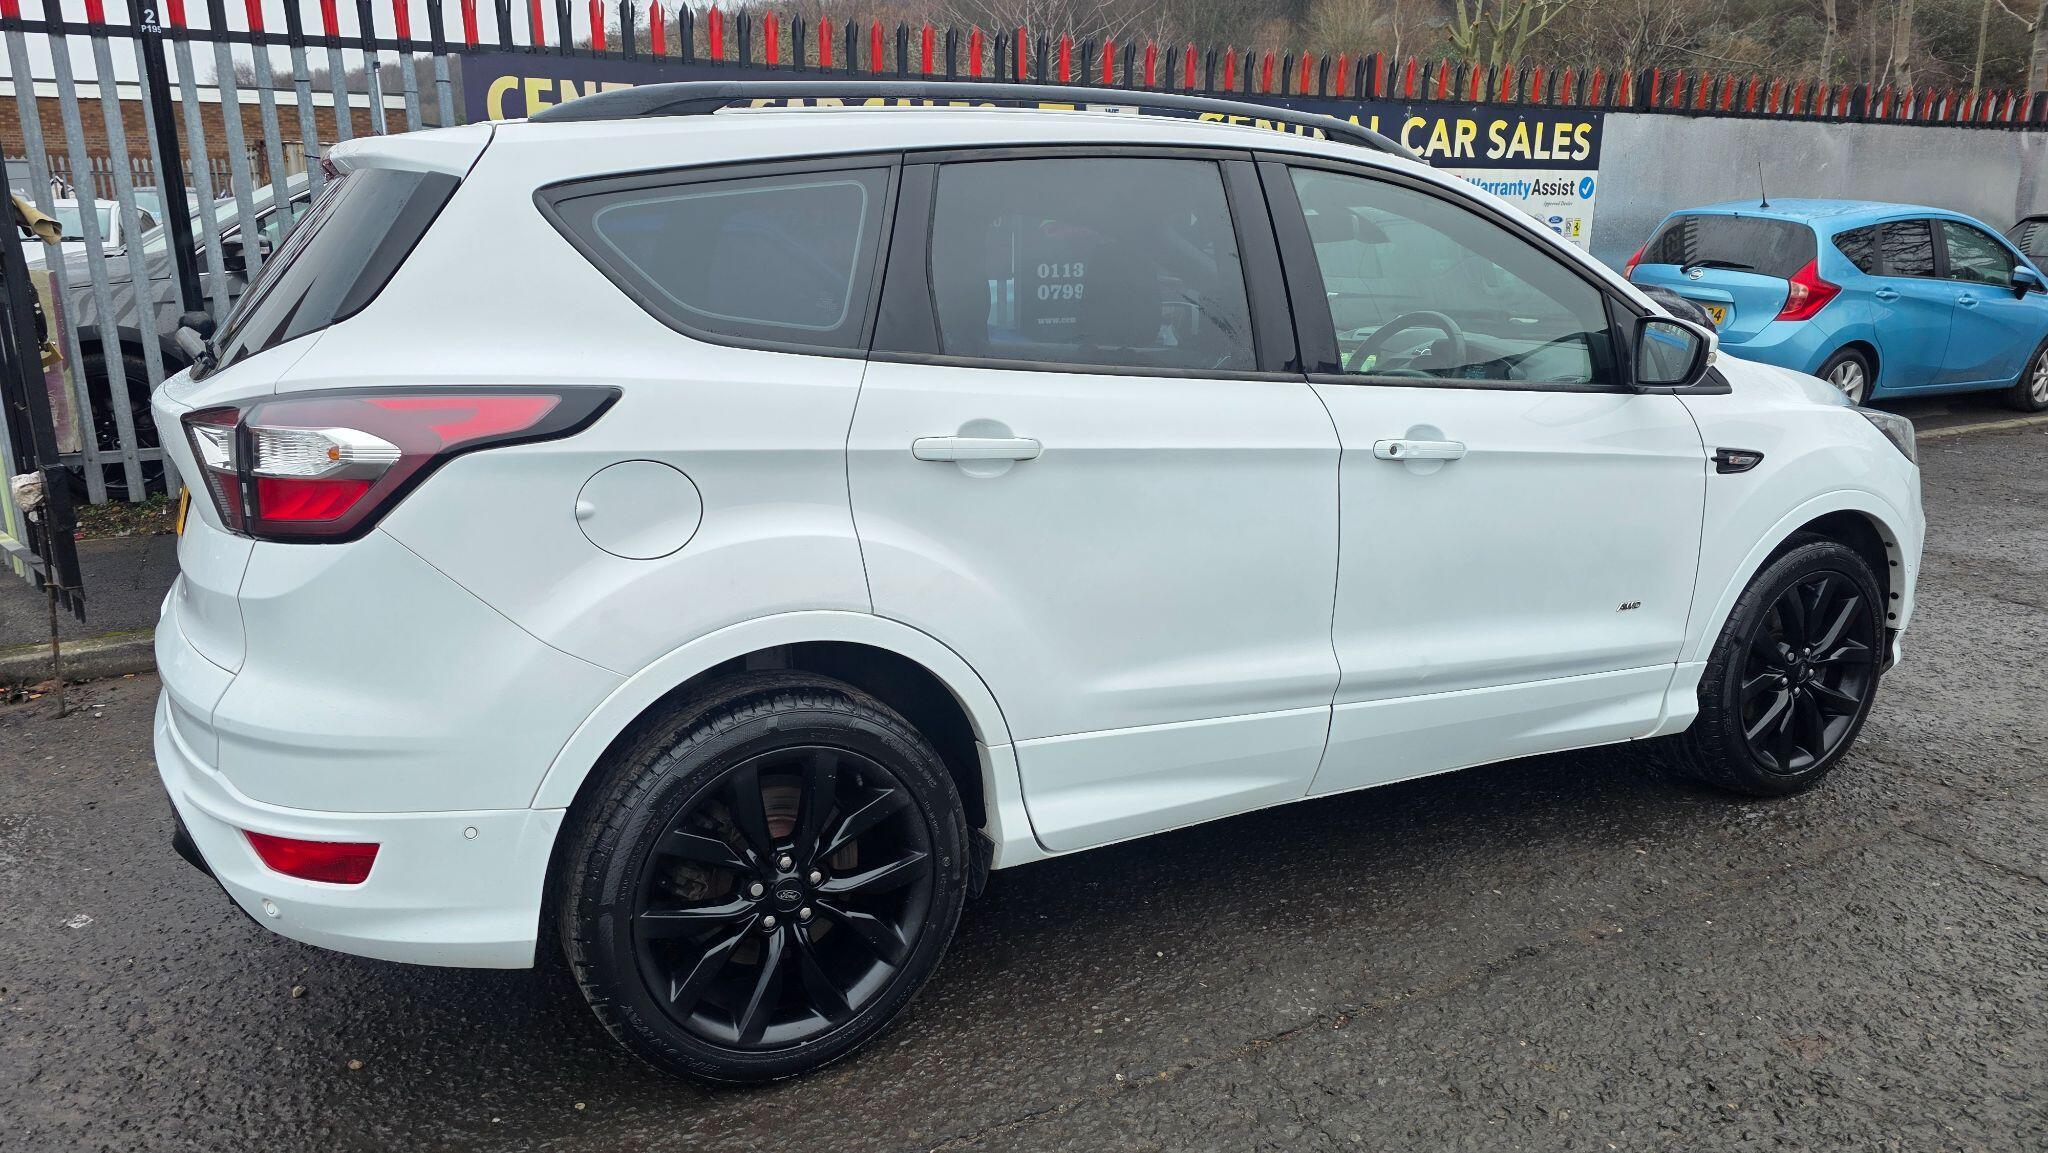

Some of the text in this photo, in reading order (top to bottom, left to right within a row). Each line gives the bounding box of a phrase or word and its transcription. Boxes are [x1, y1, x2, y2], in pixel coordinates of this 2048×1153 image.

[143, 8, 156, 24] 2
[1401, 116, 1477, 158] CAR
[1486, 119, 1592, 161] SALES
[1038, 263, 1084, 278] 0113
